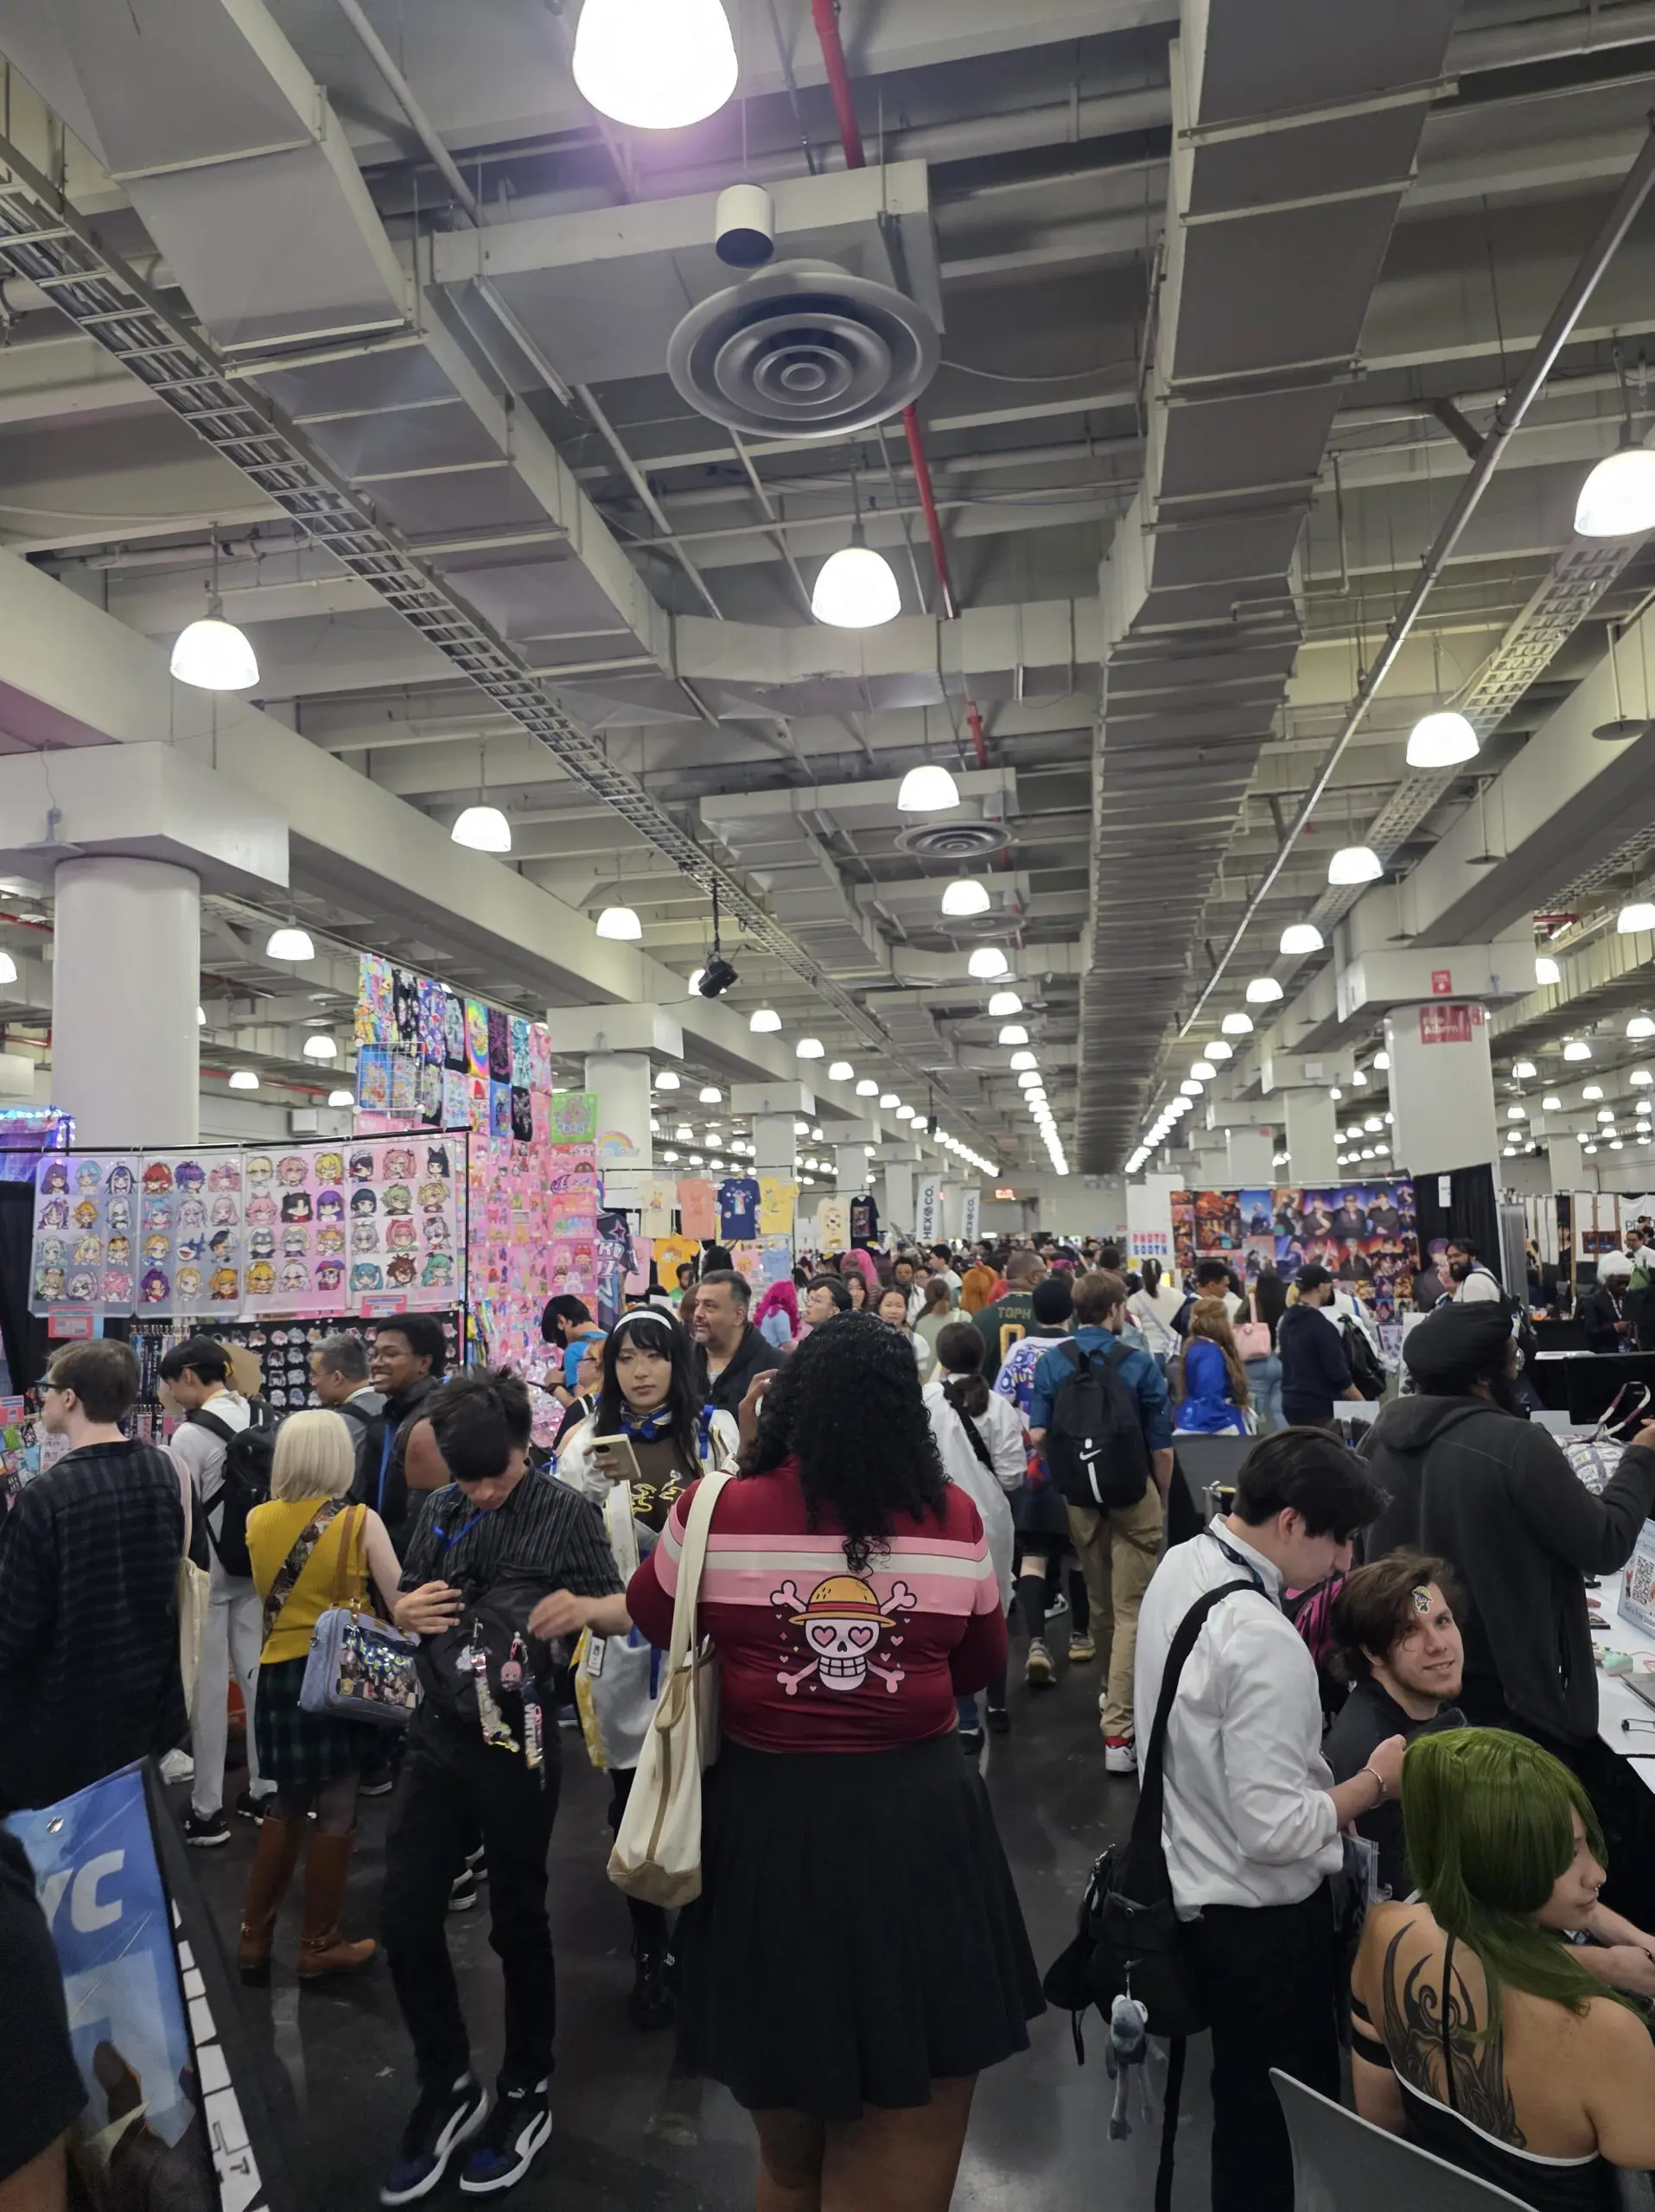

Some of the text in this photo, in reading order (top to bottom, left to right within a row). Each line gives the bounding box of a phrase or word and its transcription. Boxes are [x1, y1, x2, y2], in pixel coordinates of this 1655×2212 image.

[1132, 1232, 1167, 1244] PHOTO
[1133, 1244, 1168, 1255] BOOTH
[997, 1306, 1032, 1320] TOPH
